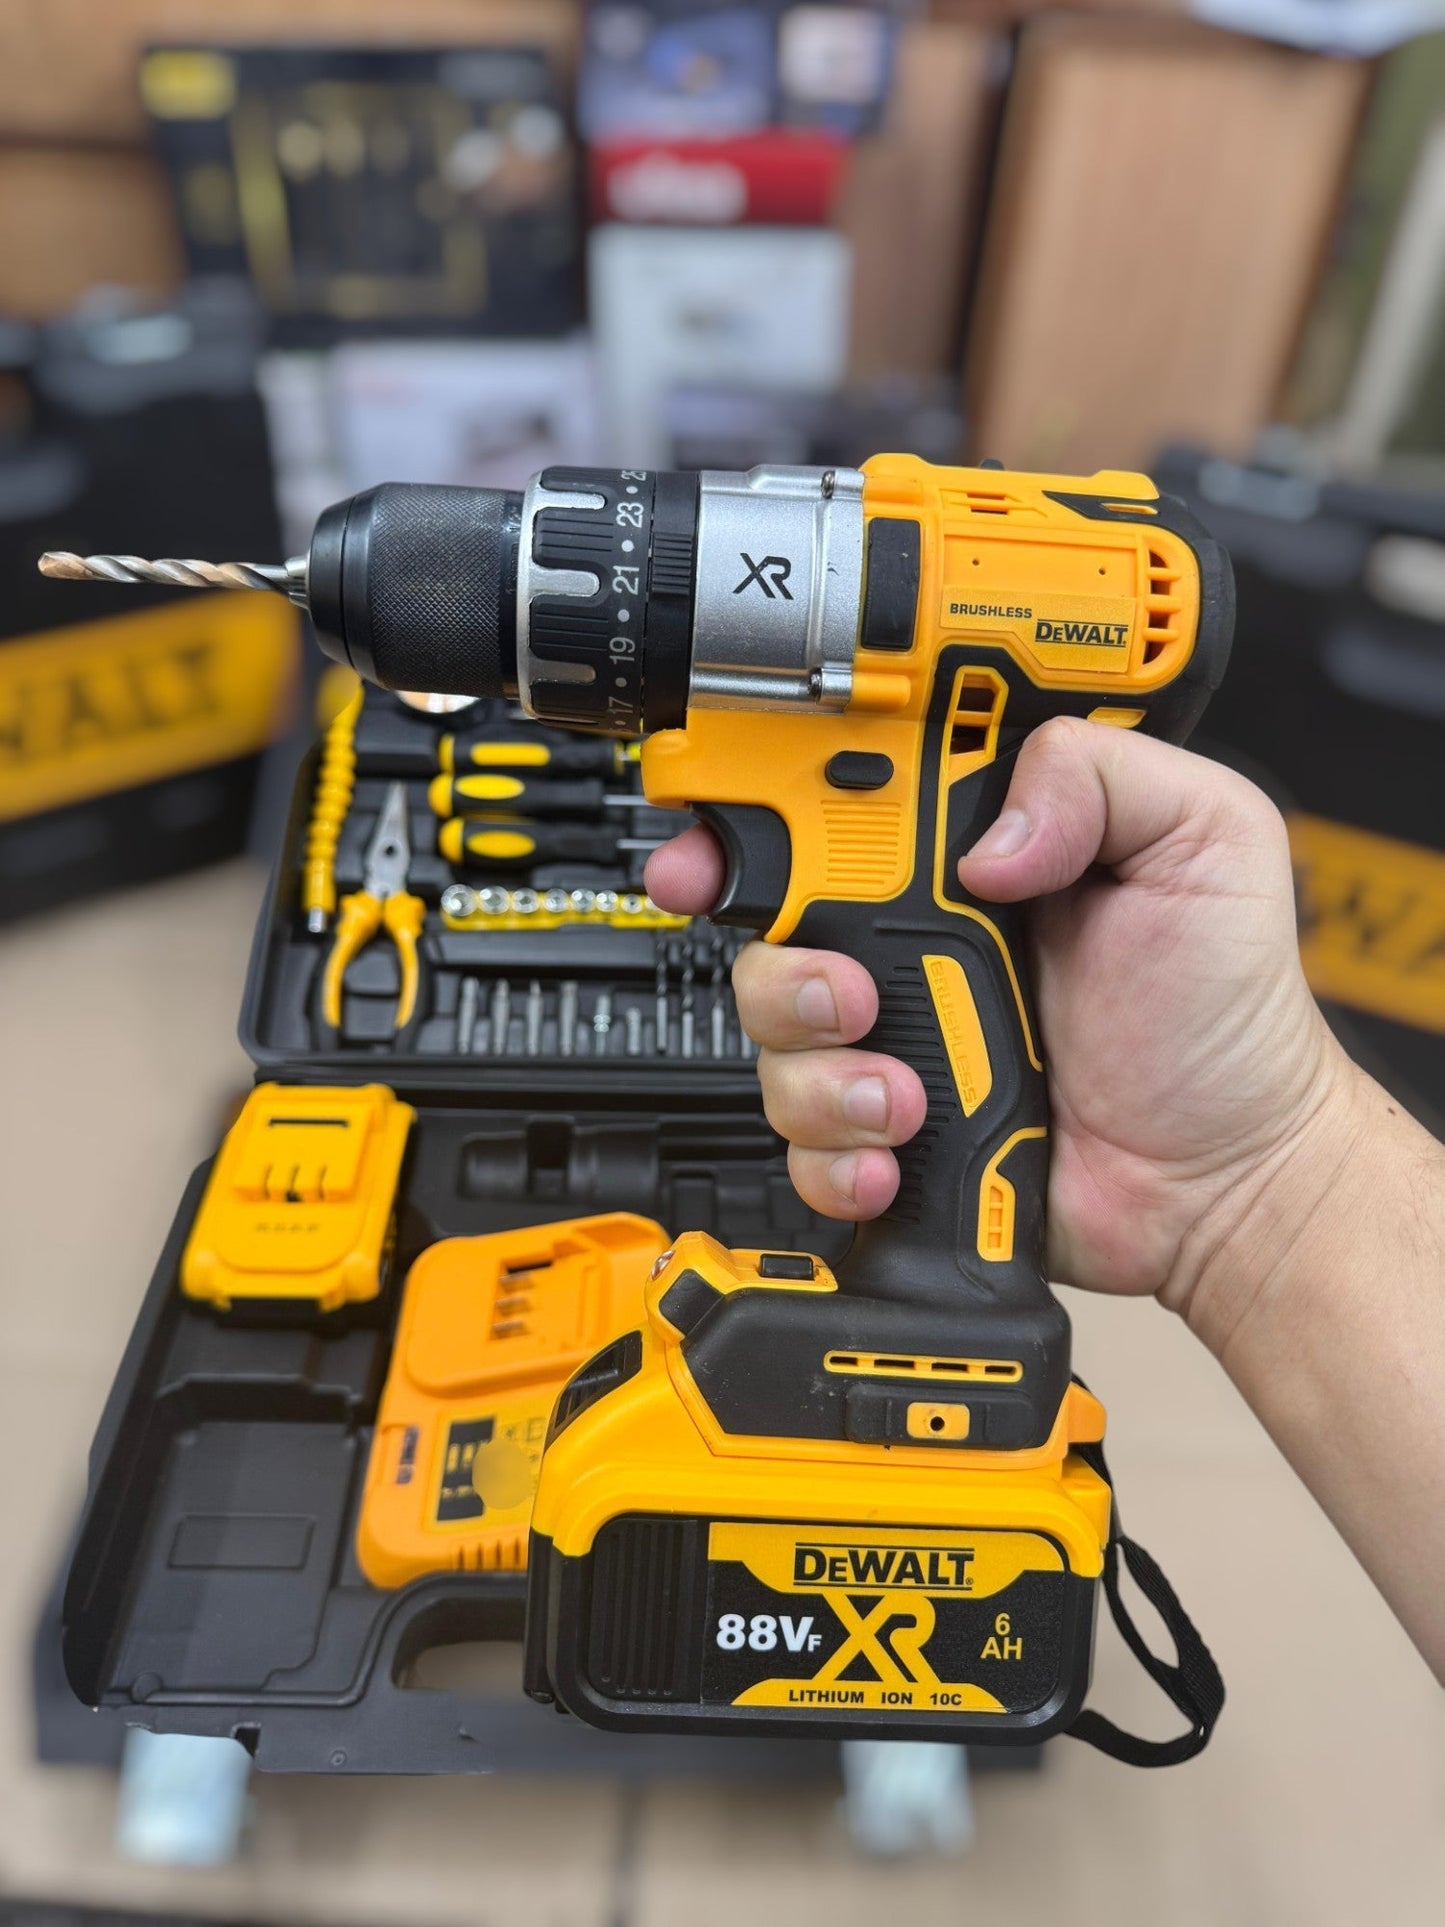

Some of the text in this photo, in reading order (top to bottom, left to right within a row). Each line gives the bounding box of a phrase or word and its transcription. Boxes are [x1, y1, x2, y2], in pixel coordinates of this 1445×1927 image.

[616, 501, 644, 528] 23
[612, 565, 640, 595] 21
[732, 552, 794, 600] XR
[950, 603, 1032, 618] BRUSHLESS
[609, 636, 636, 665] 19
[608, 696, 634, 714] 17
[929, 960, 978, 1106] BRUSHLESS
[995, 1613, 1011, 1635] 6
[811, 1593, 942, 1683] XR
[981, 1637, 1023, 1660] AH
[789, 1689, 962, 1706] LITHIUM ION 10C
